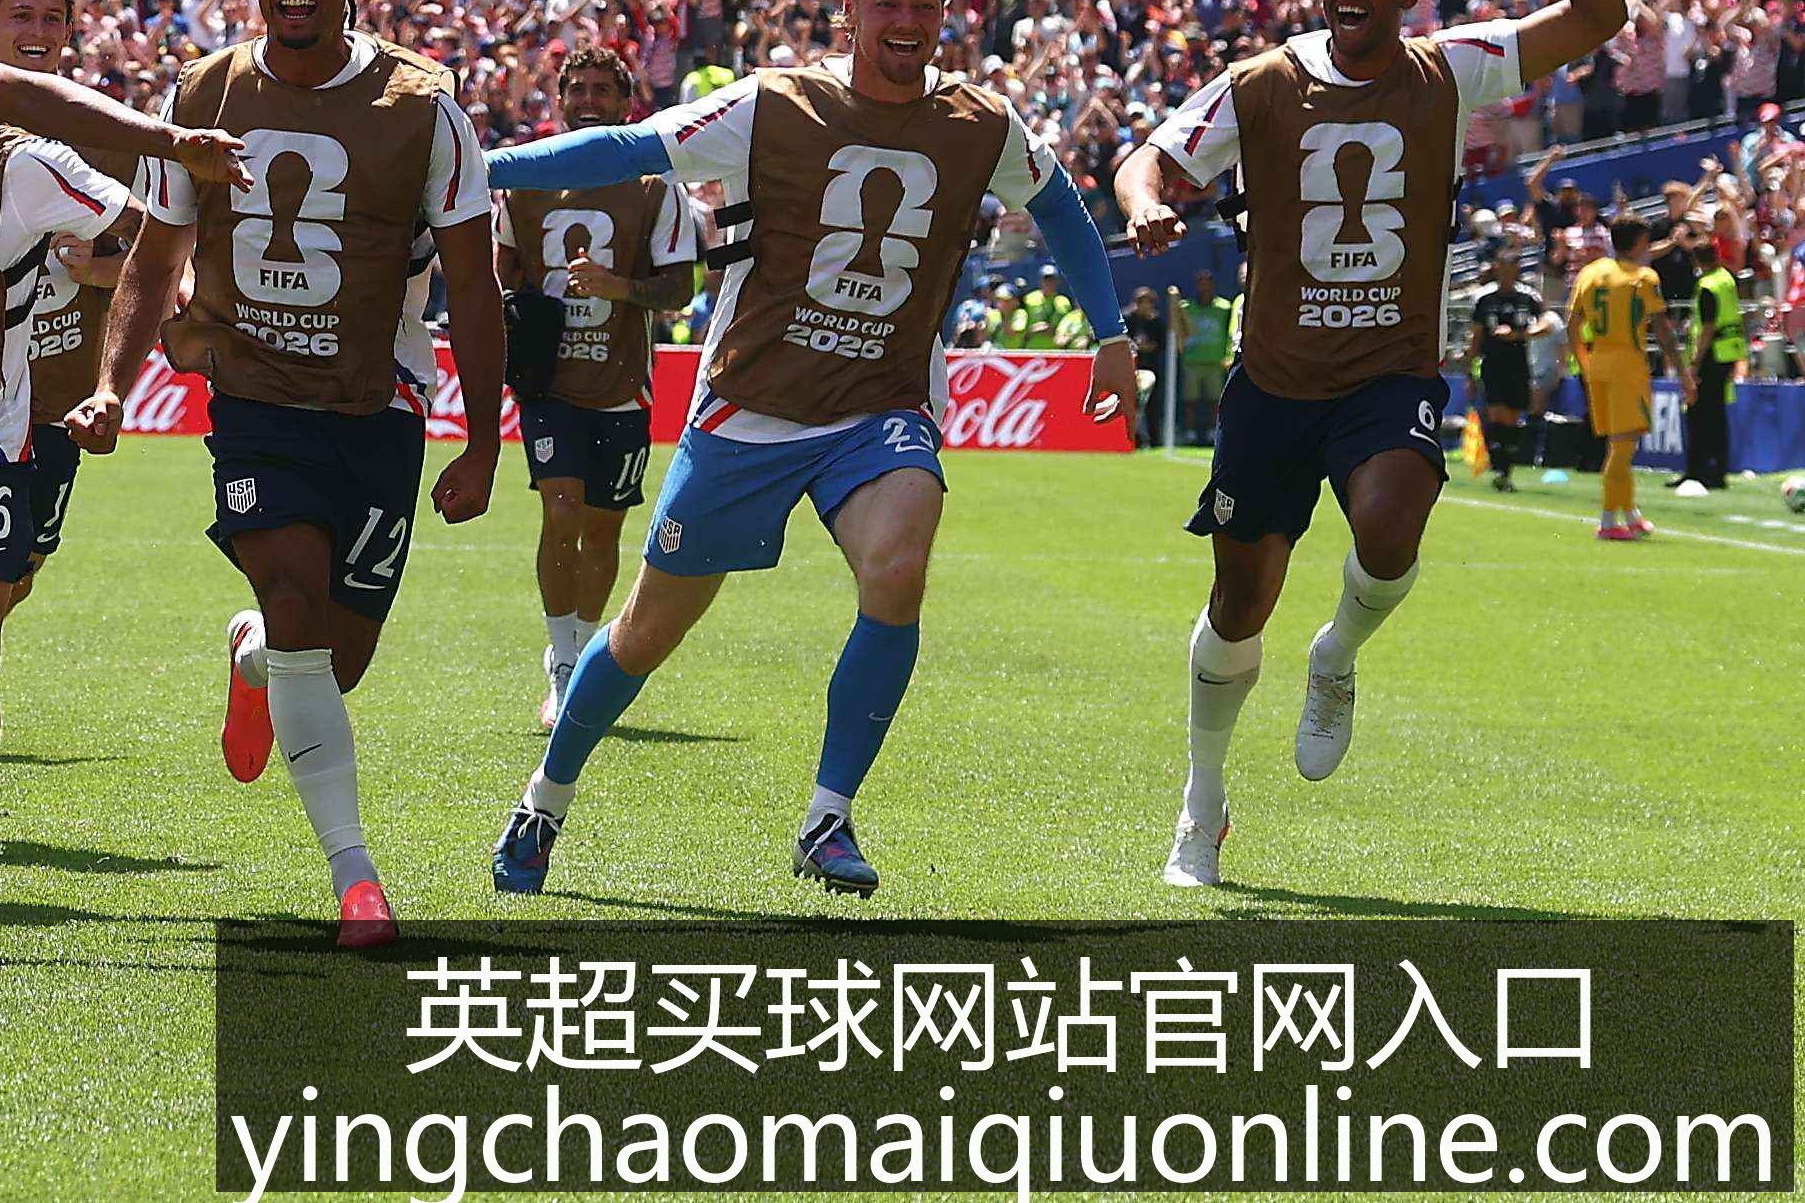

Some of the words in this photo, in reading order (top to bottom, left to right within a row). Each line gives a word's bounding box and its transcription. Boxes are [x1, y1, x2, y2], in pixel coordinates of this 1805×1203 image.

[1330, 252, 1378, 268] FIFA
[260, 269, 310, 291] FIFA
[834, 277, 883, 302] FIFA
[1300, 286, 1365, 302] WORLD
[1368, 287, 1402, 302] CUP
[52, 310, 83, 331] CUP
[235, 302, 297, 329] WORLD
[300, 313, 340, 330] CUP
[795, 307, 860, 332] WORLD
[861, 320, 895, 337] CUP
[1298, 304, 1402, 329] 2026
[235, 322, 340, 357] 2026
[584, 332, 612, 343] CUP
[783, 324, 886, 360] 2026
[557, 343, 609, 363] 026
[1417, 399, 1436, 432] 6
[615, 447, 647, 490] 10
[227, 479, 256, 496] USA
[662, 518, 682, 536] USA
[345, 507, 407, 579] 12
